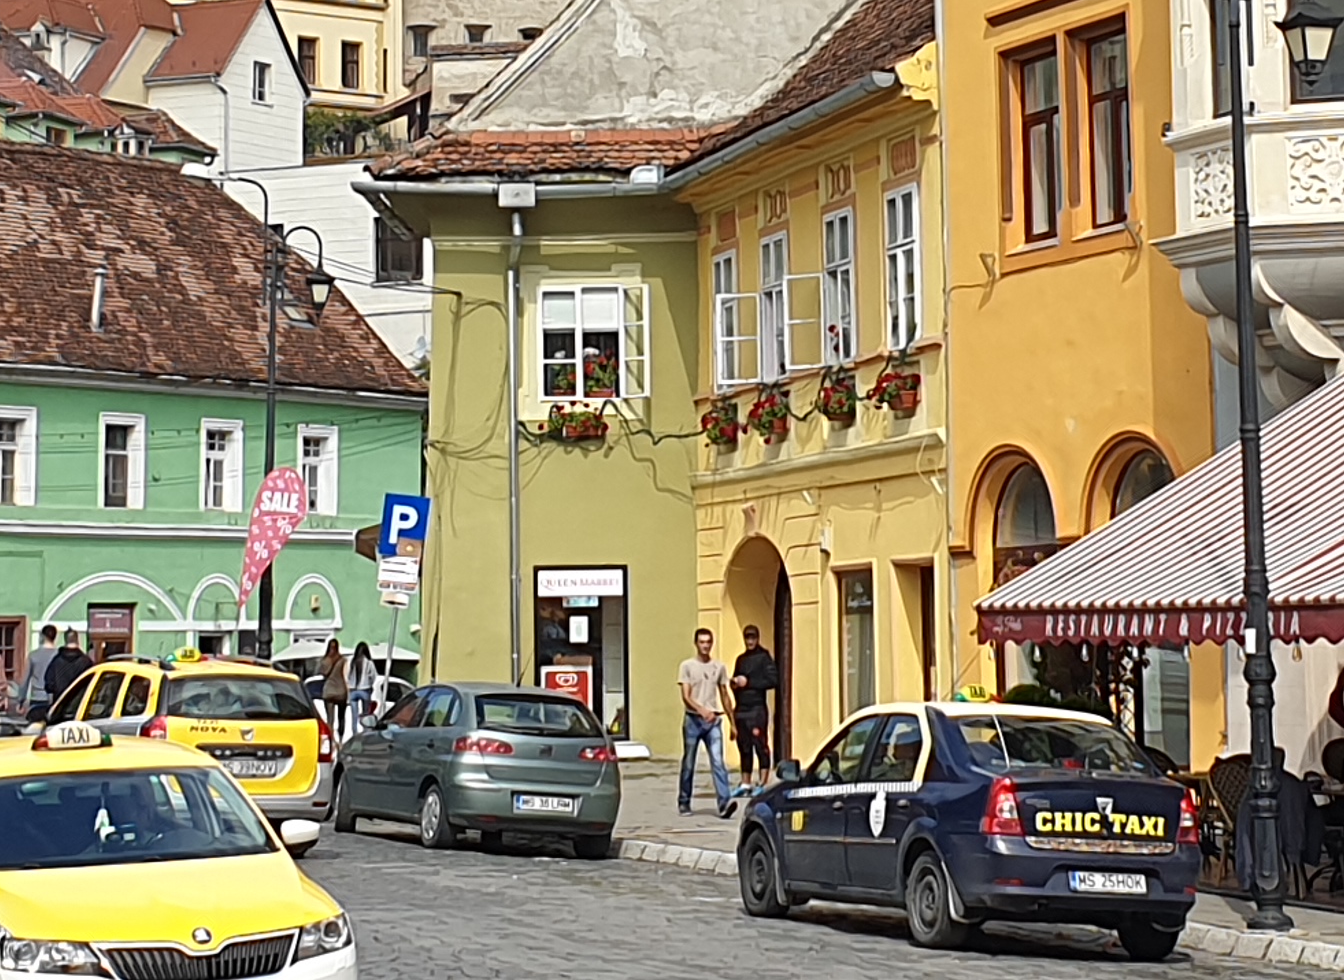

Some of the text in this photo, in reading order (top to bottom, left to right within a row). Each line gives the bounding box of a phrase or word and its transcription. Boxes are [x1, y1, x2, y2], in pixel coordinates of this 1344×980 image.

[259, 490, 300, 514] SALE
[388, 503, 419, 545] P
[1044, 612, 1168, 638] RESTAURANT
[1178, 612, 1190, 636] &
[1201, 610, 1302, 637] PIZZRIA
[59, 725, 91, 745] TAXI
[189, 725, 228, 734] NOVA
[1034, 810, 1166, 838] CHIC TAXI
[1078, 873, 1144, 890] MS 25HOK
